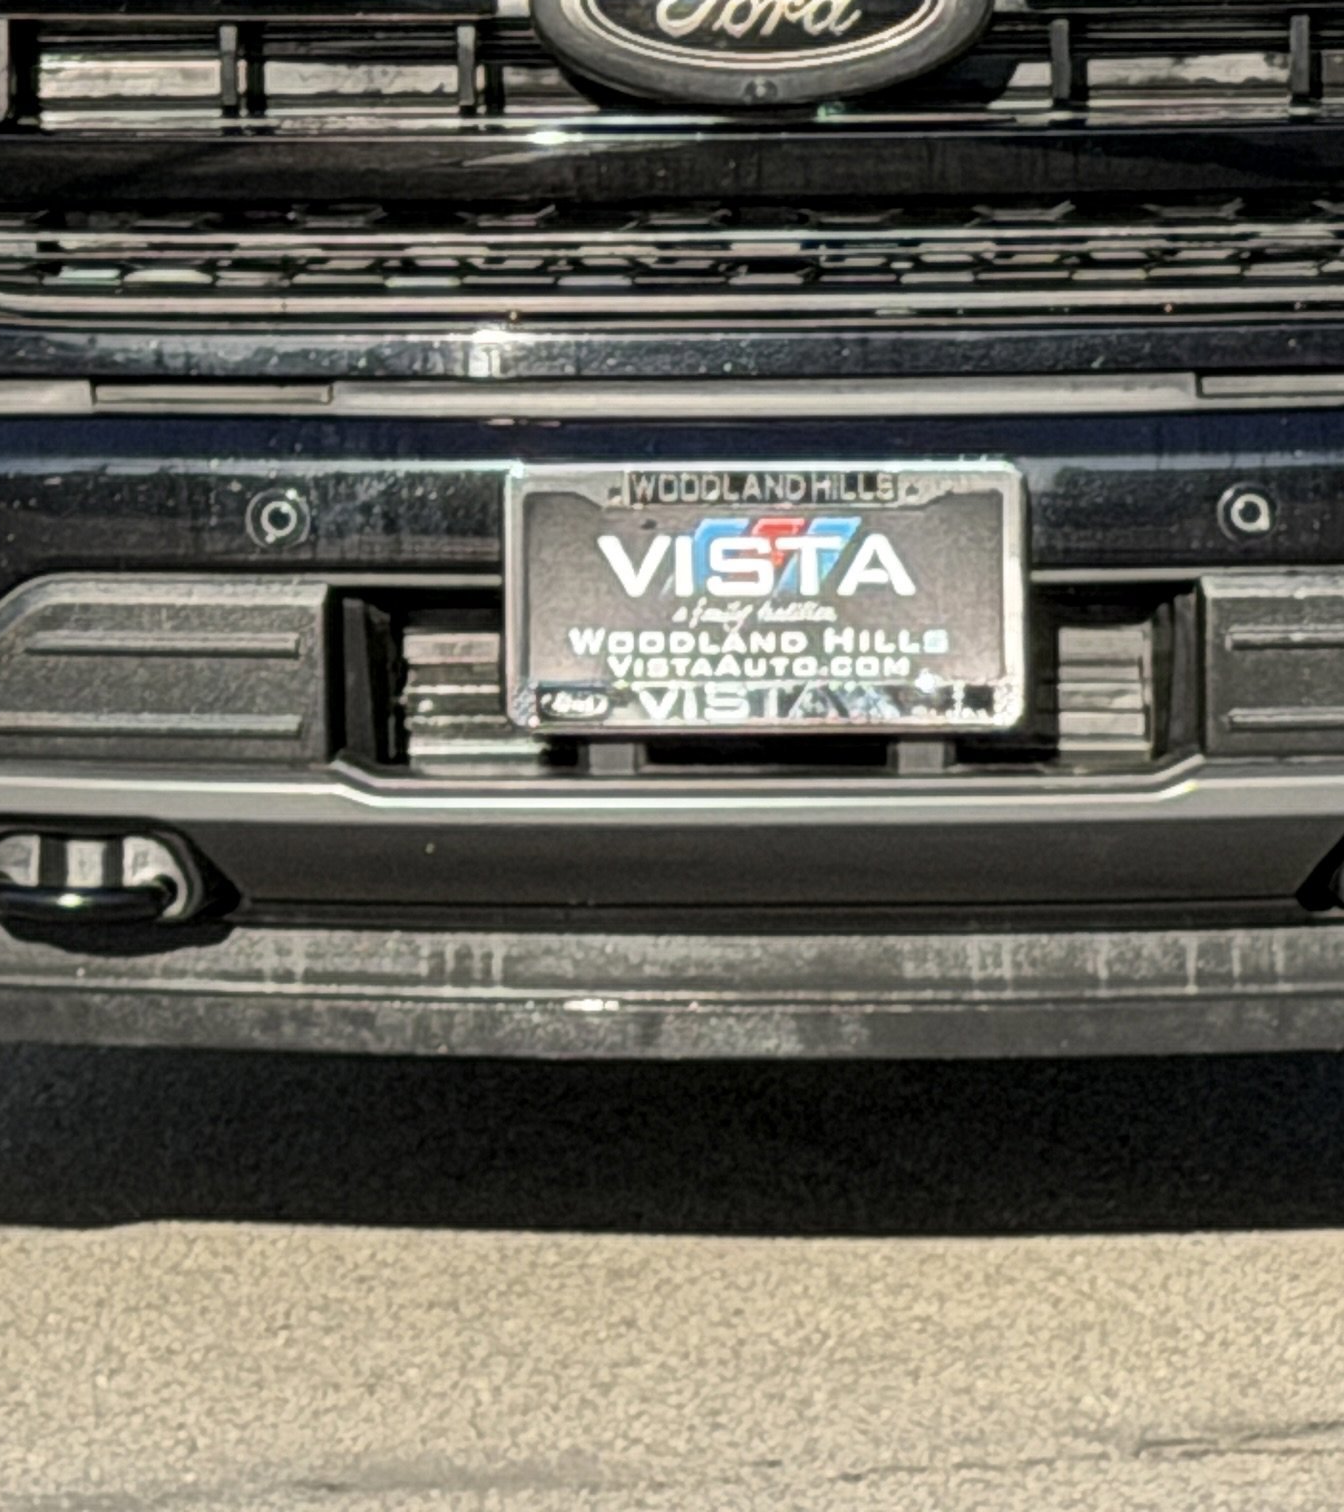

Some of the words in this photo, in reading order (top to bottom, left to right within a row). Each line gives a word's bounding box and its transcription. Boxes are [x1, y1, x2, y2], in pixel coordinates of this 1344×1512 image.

[630, 472, 806, 503] WOODLAND
[810, 472, 895, 502] HILLS
[596, 532, 917, 597] VISTA
[568, 626, 809, 656] WOODLAND
[822, 625, 950, 655] HILLS
[633, 682, 850, 720] VISTA
